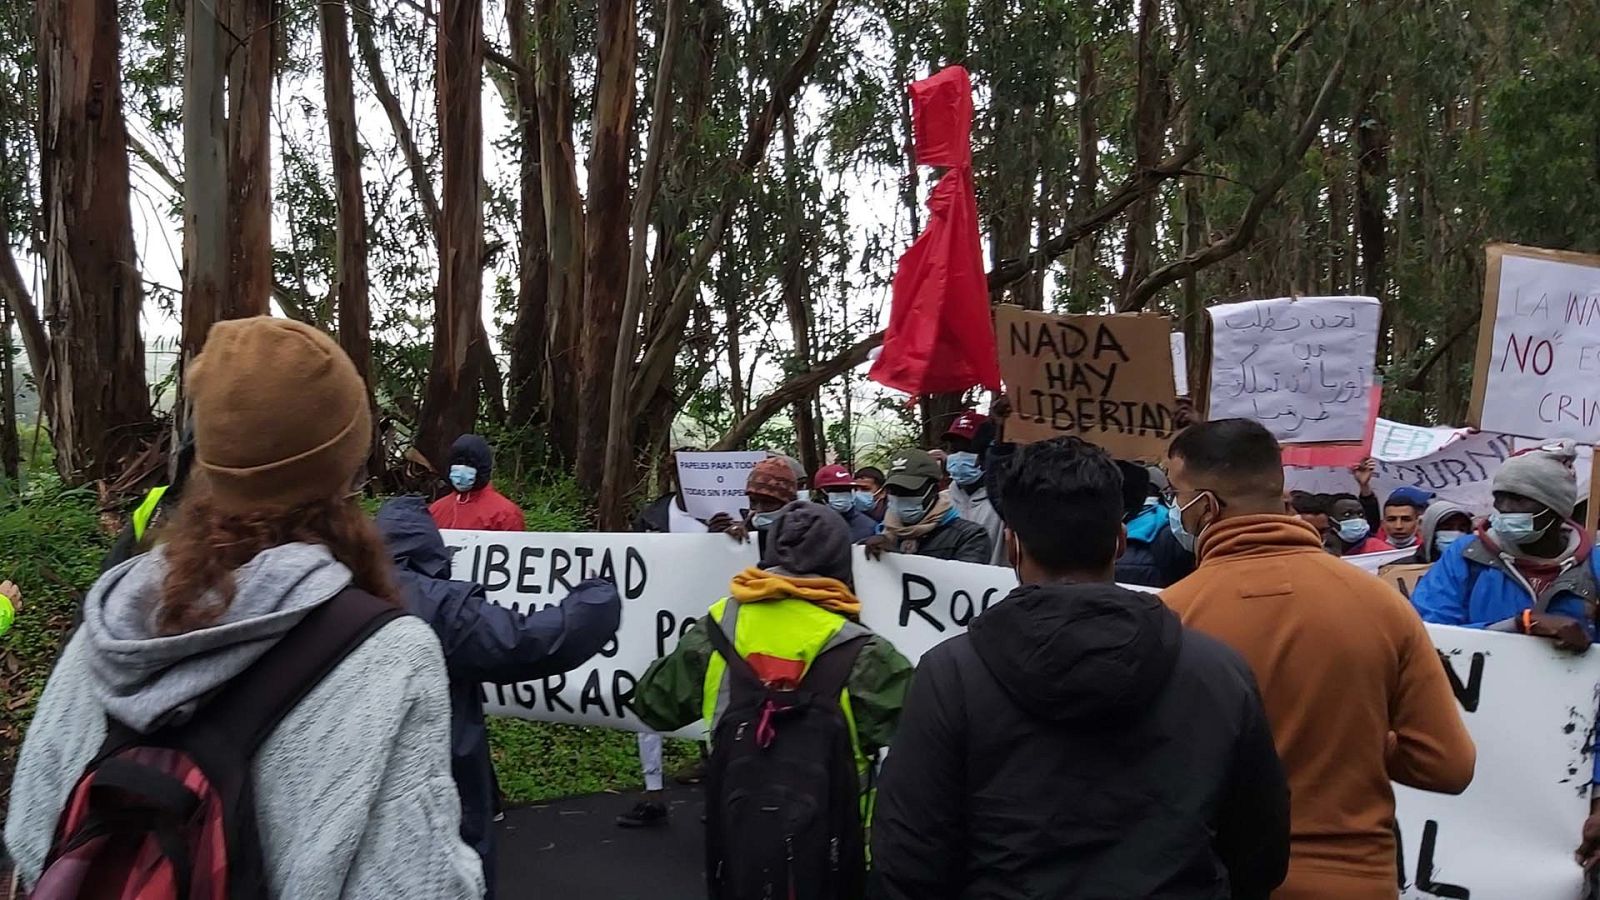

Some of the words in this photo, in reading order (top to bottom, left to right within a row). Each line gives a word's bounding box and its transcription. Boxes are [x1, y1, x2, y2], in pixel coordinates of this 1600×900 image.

[1515, 287, 1549, 319] LA
[1010, 321, 1130, 362] NADA
[1500, 332, 1553, 376] NO
[1578, 345, 1600, 371] E
[1045, 362, 1118, 397] HAY
[1016, 386, 1174, 440] LIBERTAD
[679, 461, 710, 470] PAPELES
[711, 462, 734, 470] PARA
[716, 475, 725, 484] O
[683, 487, 706, 496] TODAS
[707, 489, 721, 497] SIN
[722, 489, 746, 497] PAPE
[449, 544, 647, 600] IBERTAD
